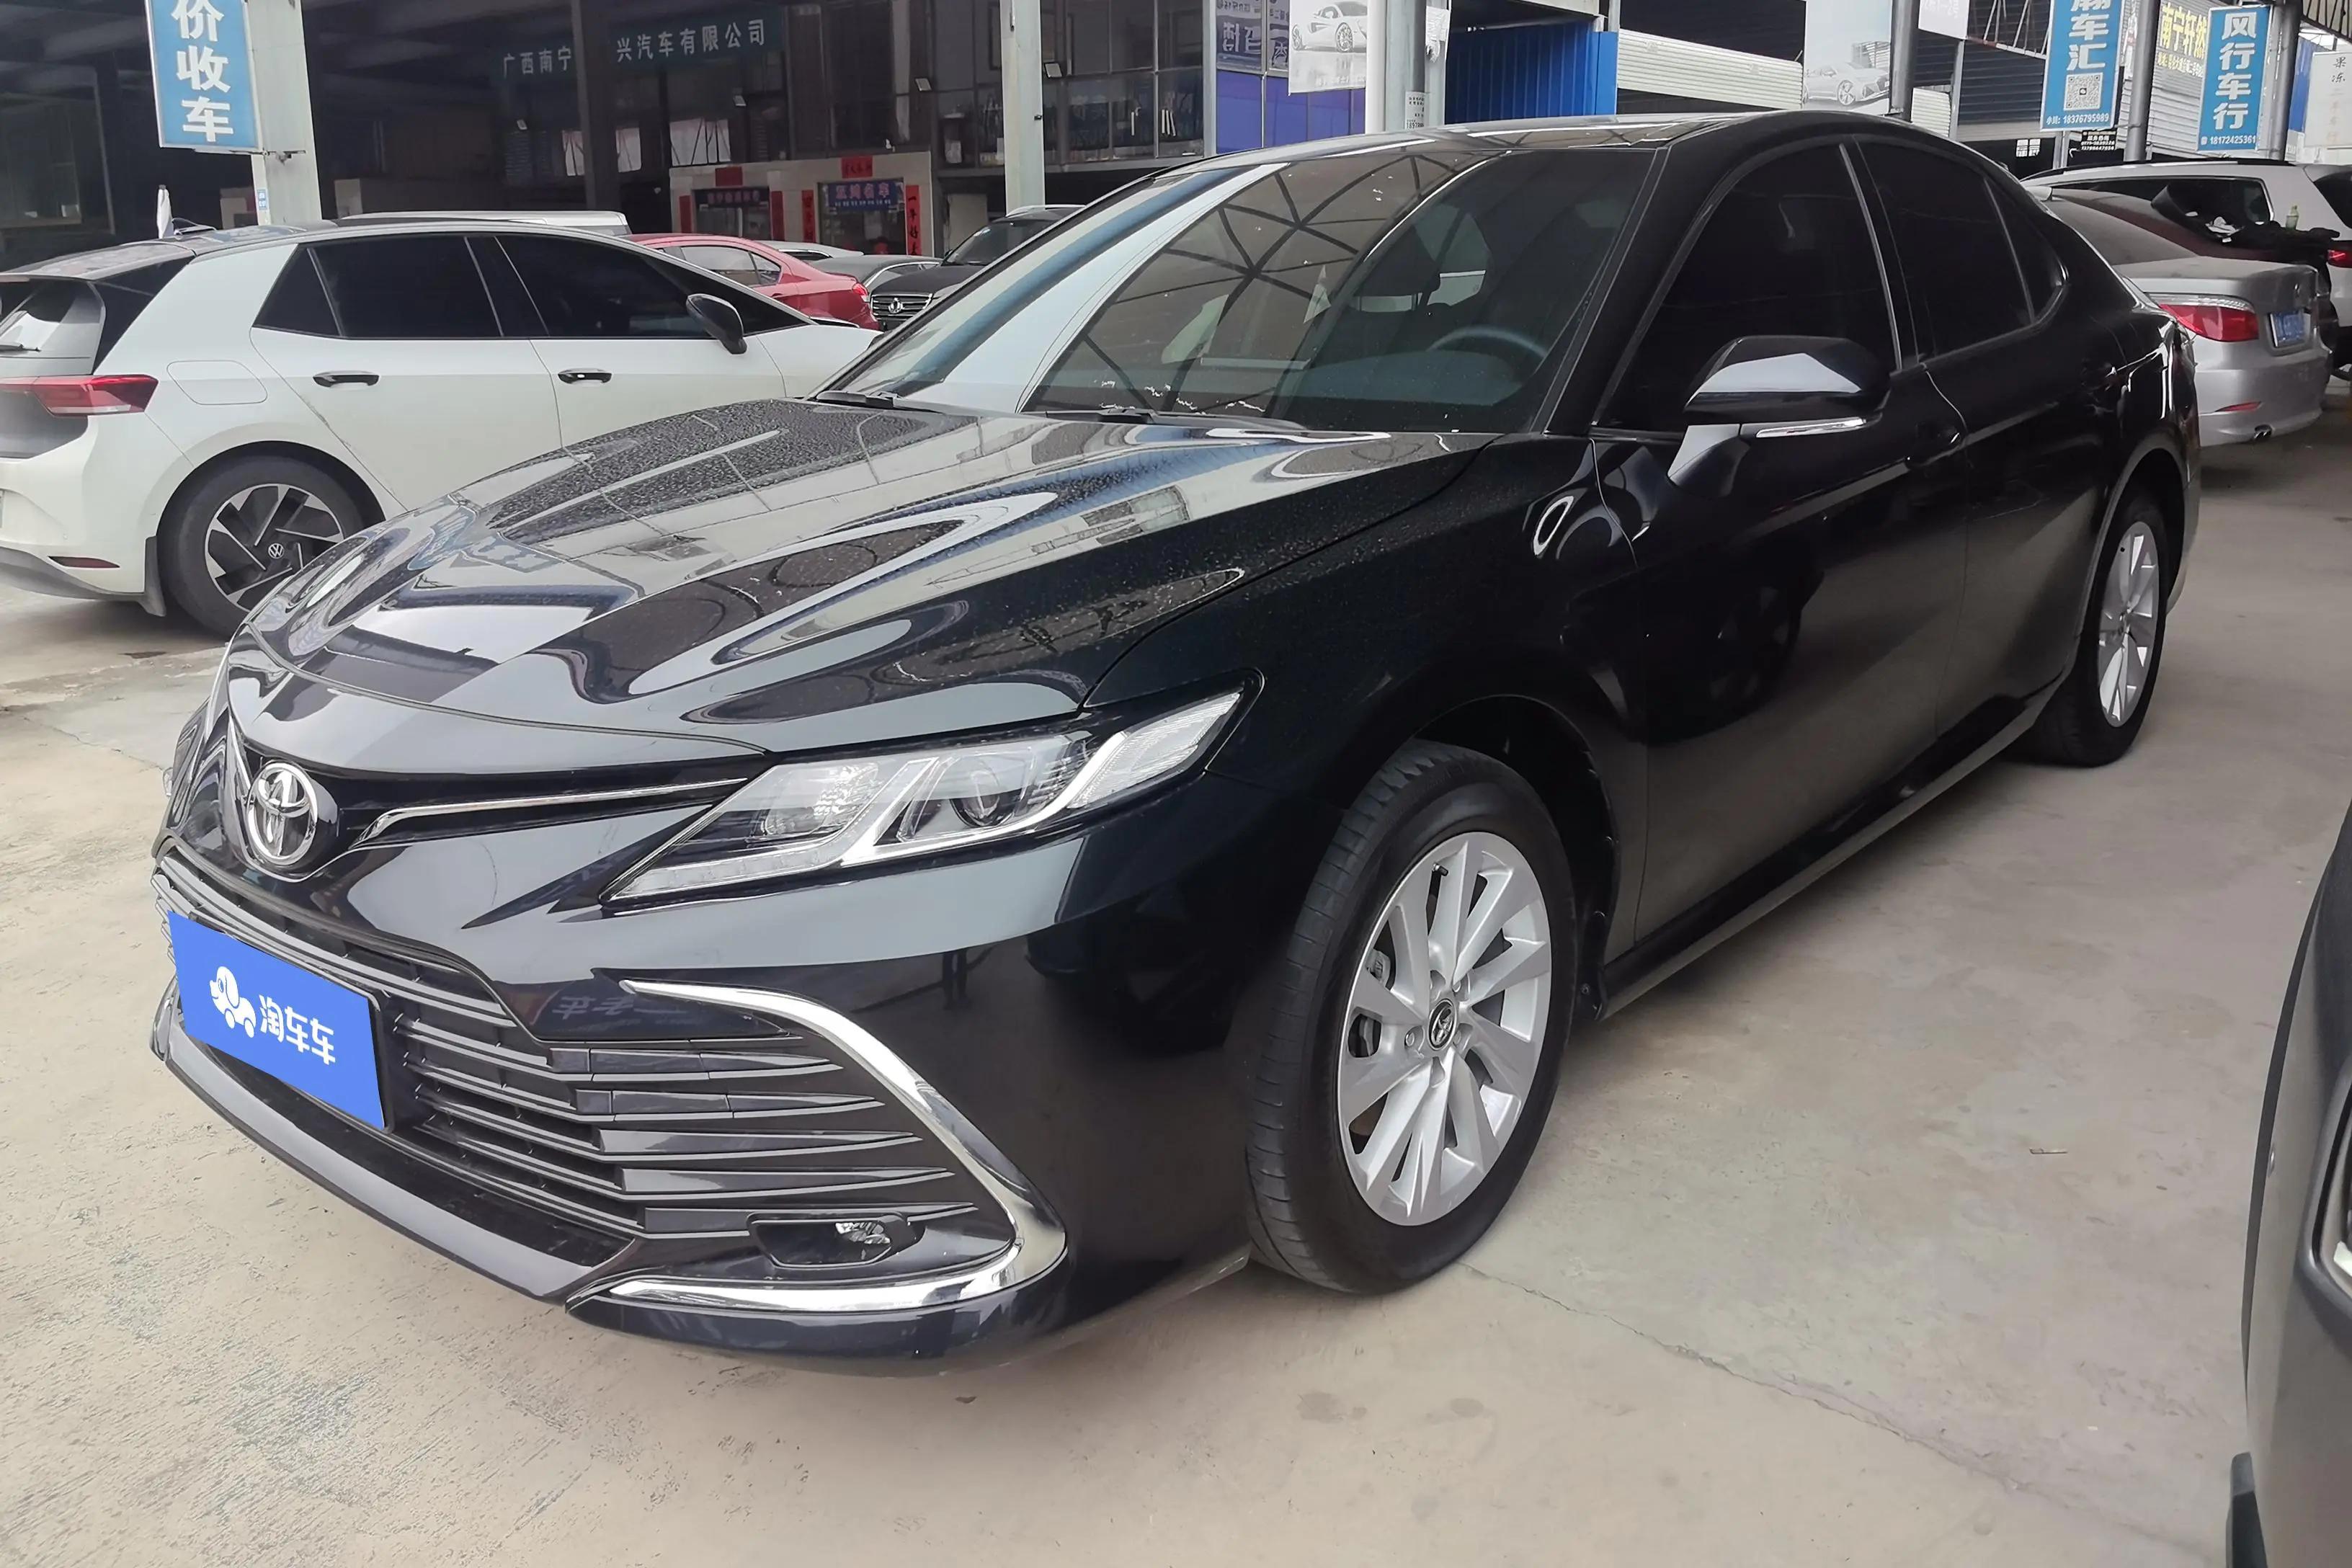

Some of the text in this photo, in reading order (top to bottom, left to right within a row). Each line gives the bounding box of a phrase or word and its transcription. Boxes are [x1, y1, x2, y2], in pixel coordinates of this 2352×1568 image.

[171, 0, 234, 142] 价收车
[2213, 12, 2257, 130] 风行车行
[2062, 112, 2110, 124] 18376795989
[2209, 135, 2256, 145] 18172425361
